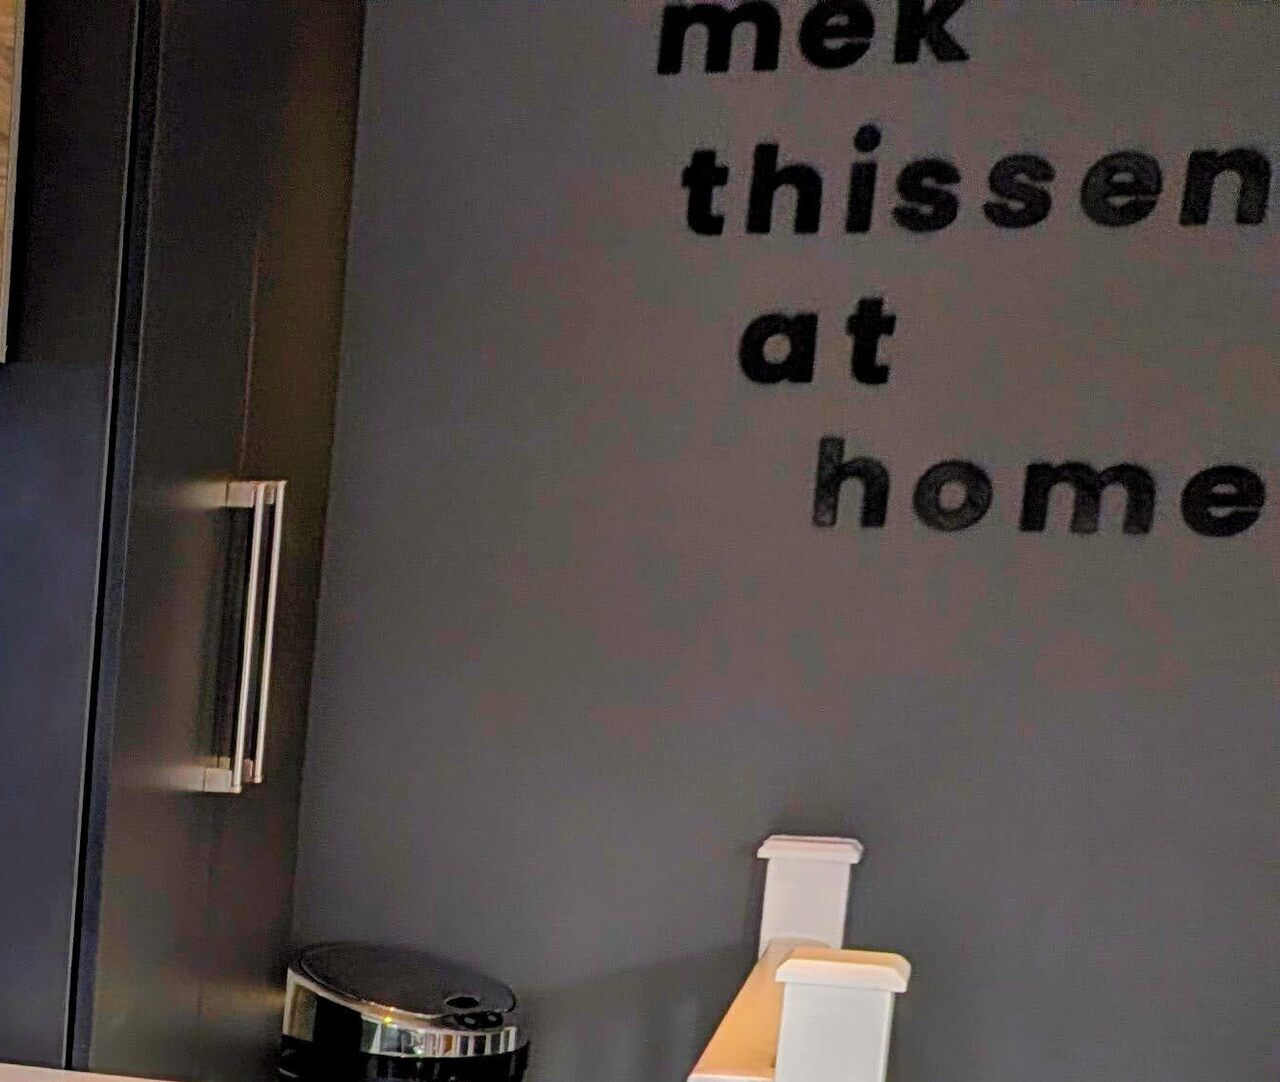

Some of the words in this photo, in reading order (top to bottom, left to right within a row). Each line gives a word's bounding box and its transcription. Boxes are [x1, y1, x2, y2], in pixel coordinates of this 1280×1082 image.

[657, 0, 970, 75] mek
[682, 124, 1273, 236] thissen
[739, 297, 897, 385] at
[812, 436, 1267, 538] home
